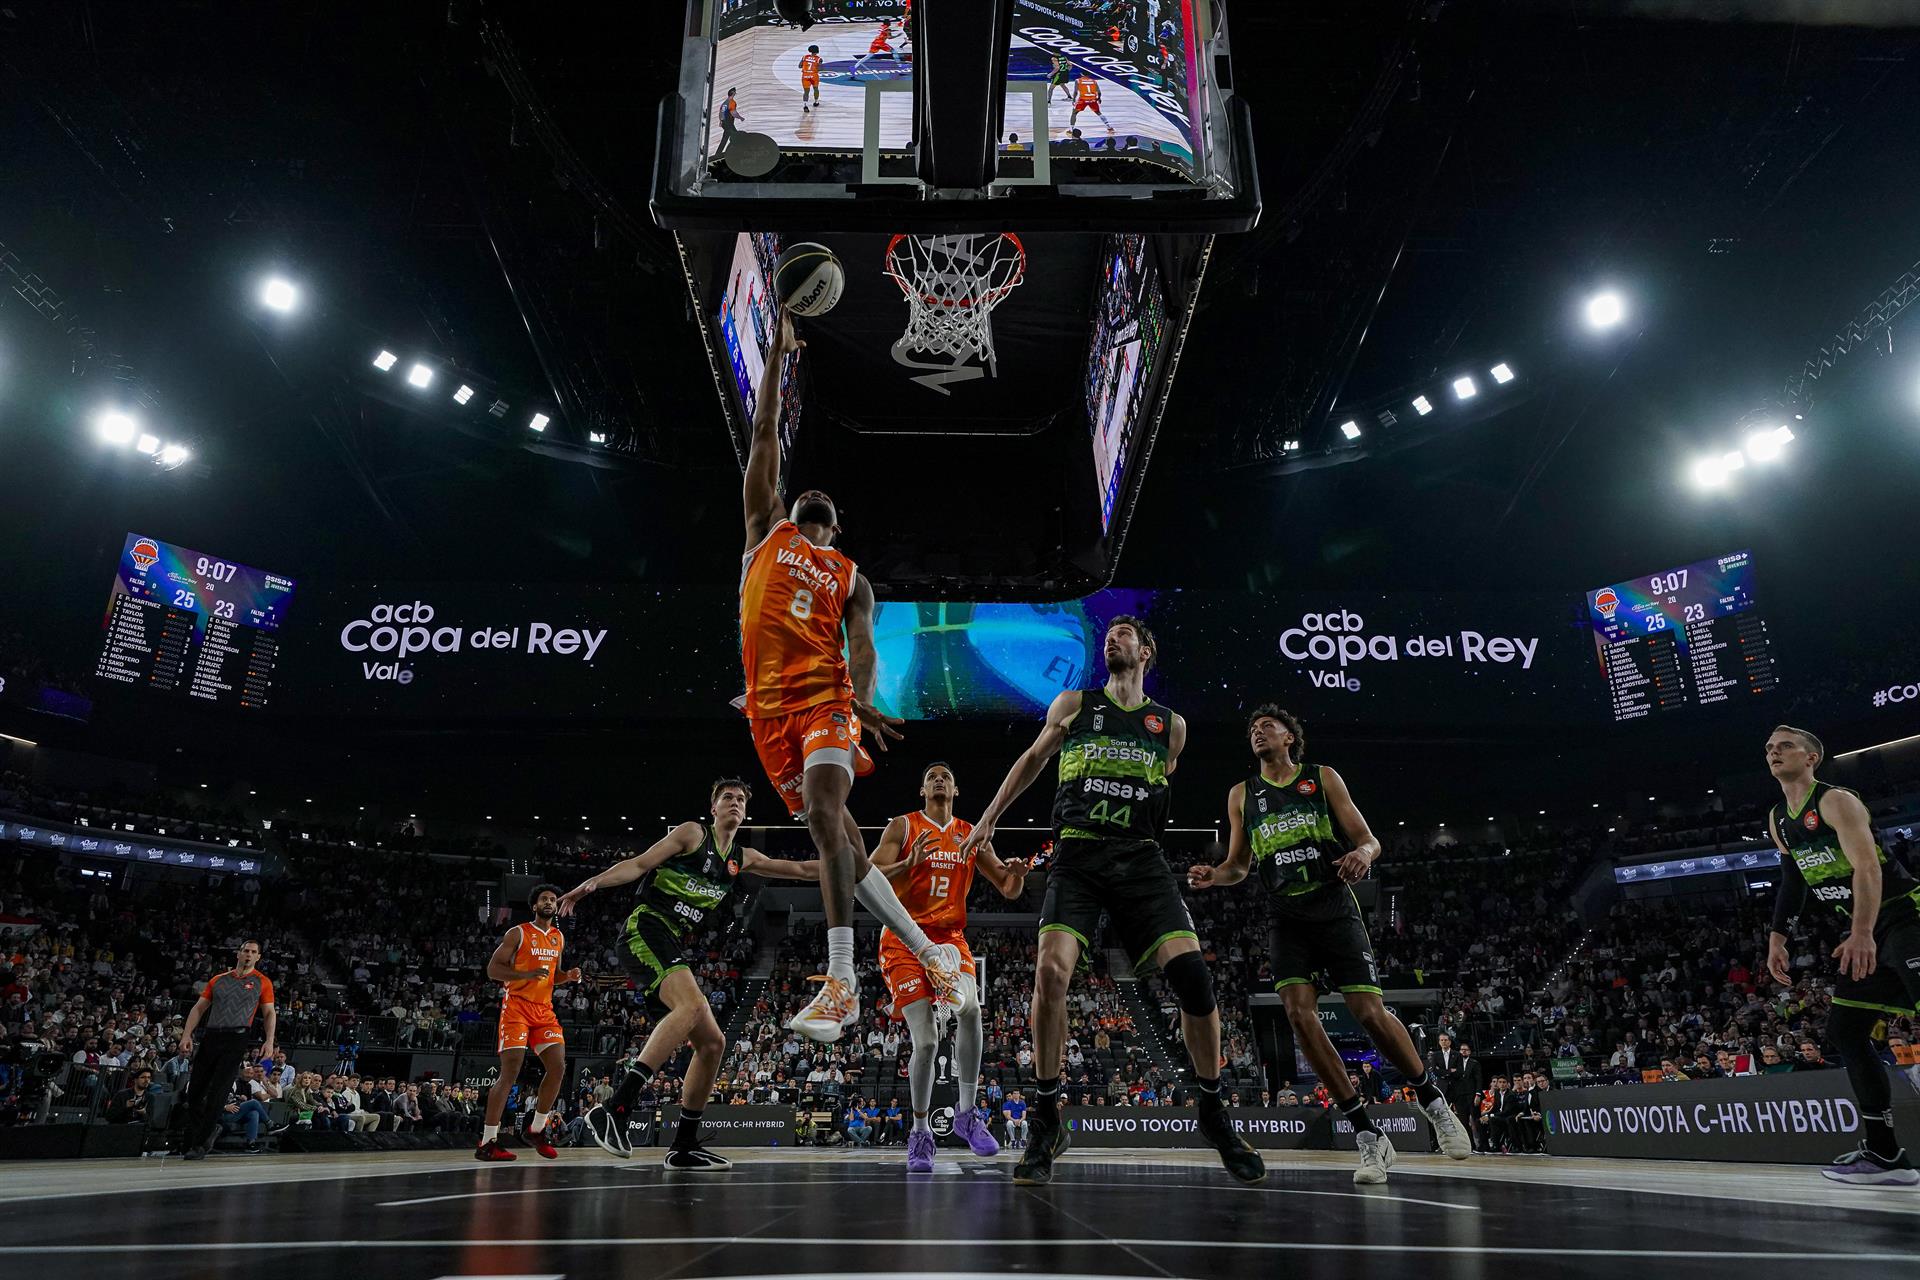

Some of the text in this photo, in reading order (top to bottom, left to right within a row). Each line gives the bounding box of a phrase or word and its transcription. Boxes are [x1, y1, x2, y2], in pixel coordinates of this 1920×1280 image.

[196, 557, 237, 583] 9:07
[776, 548, 839, 596] VALENCIA
[788, 567, 822, 591] BASKET
[1651, 570, 1688, 595] 9:07
[173, 590, 195, 608] 25
[214, 600, 235, 619] 23
[790, 590, 813, 620] 8
[371, 601, 434, 623] acb
[1302, 610, 1363, 632] acb
[1646, 613, 1665, 632] 25
[1684, 604, 1704, 622] 23
[341, 620, 608, 660] Copa del Rey
[1279, 628, 1539, 669] Copa del Rey
[1873, 682, 1920, 707] #Co
[1084, 743, 1156, 767] Bressol
[1090, 800, 1131, 828] 44
[1297, 865, 1308, 881] 1
[930, 876, 949, 897] 12
[531, 948, 559, 957] VALENCIA
[629, 1121, 648, 1131] Rey
[1082, 1119, 1198, 1132] NUEVO TOYOTA
[1250, 1120, 1305, 1133] HYBRID
[1393, 1117, 1416, 1132] HYBRID
[1560, 1098, 1859, 1134] NUEVO TOYOTA C-HR HYBRID
